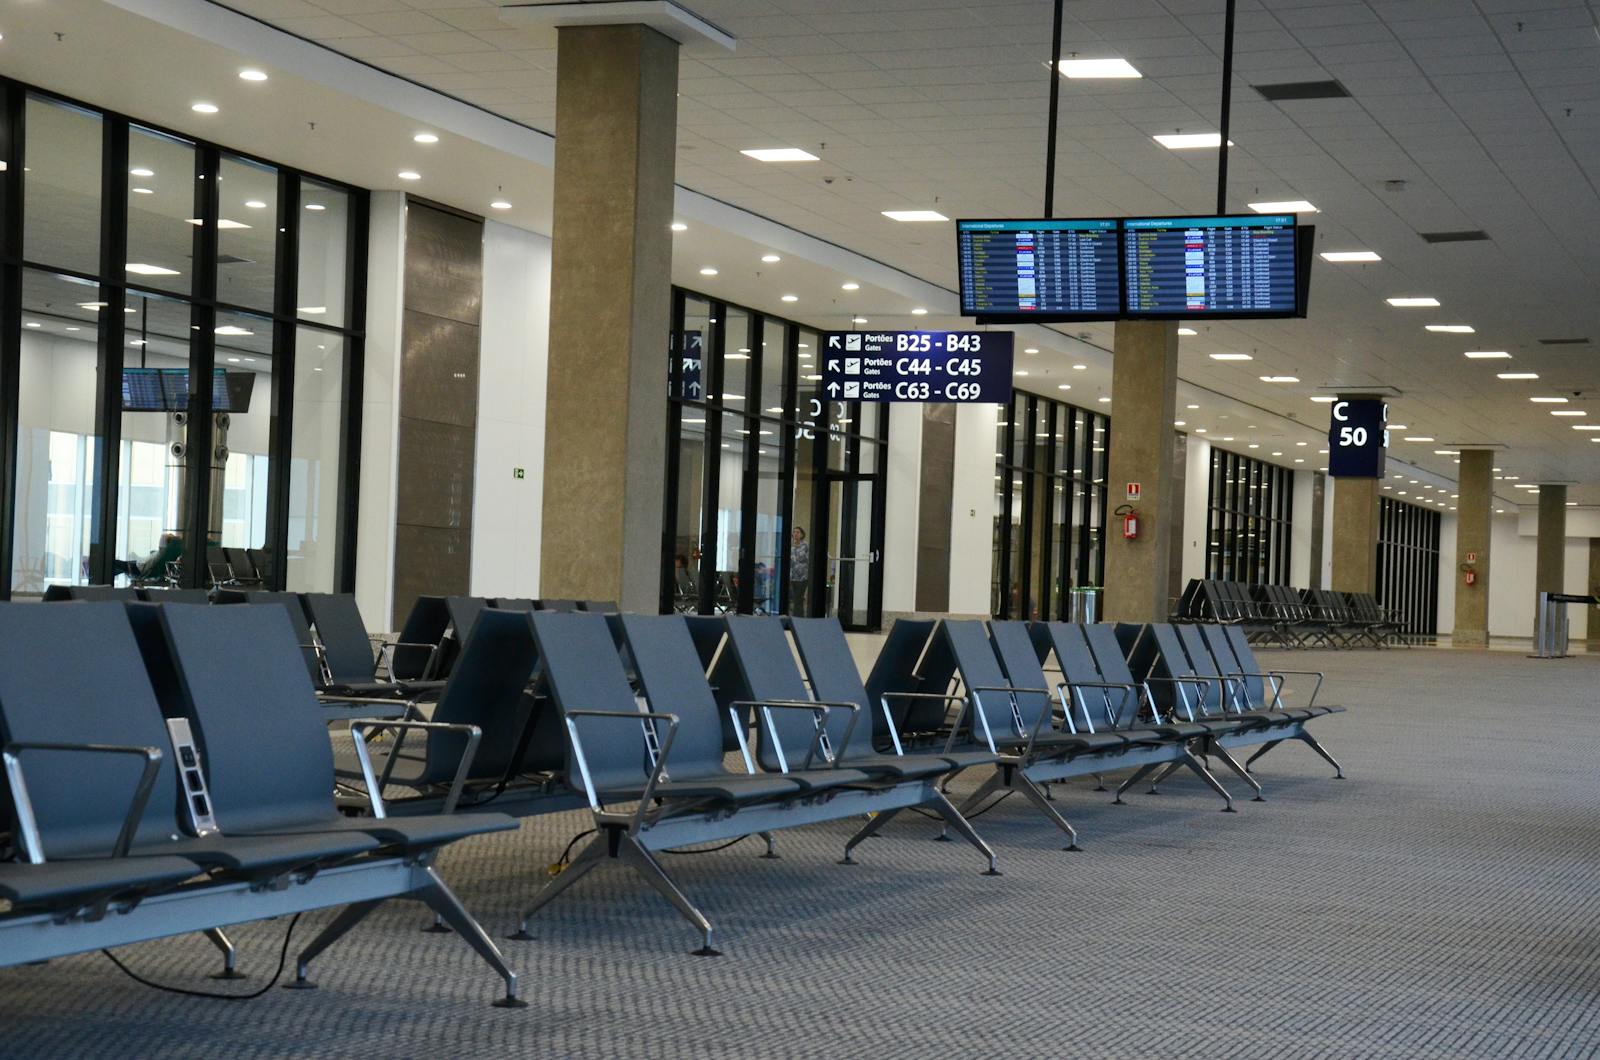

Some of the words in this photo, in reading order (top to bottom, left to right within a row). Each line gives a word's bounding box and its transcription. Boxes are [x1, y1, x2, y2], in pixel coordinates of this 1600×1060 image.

[865, 334, 893, 343] Portões
[896, 334, 931, 352] B25
[946, 334, 981, 352] B43
[865, 344, 881, 352] Gates
[864, 358, 892, 367] Portões
[896, 358, 931, 376] C44
[946, 358, 981, 376] C45
[863, 381, 891, 391] Portões
[895, 382, 930, 400] C63
[945, 382, 981, 400] C69
[863, 391, 879, 399] Gates
[1333, 401, 1349, 421] C
[1339, 427, 1368, 447] 50
